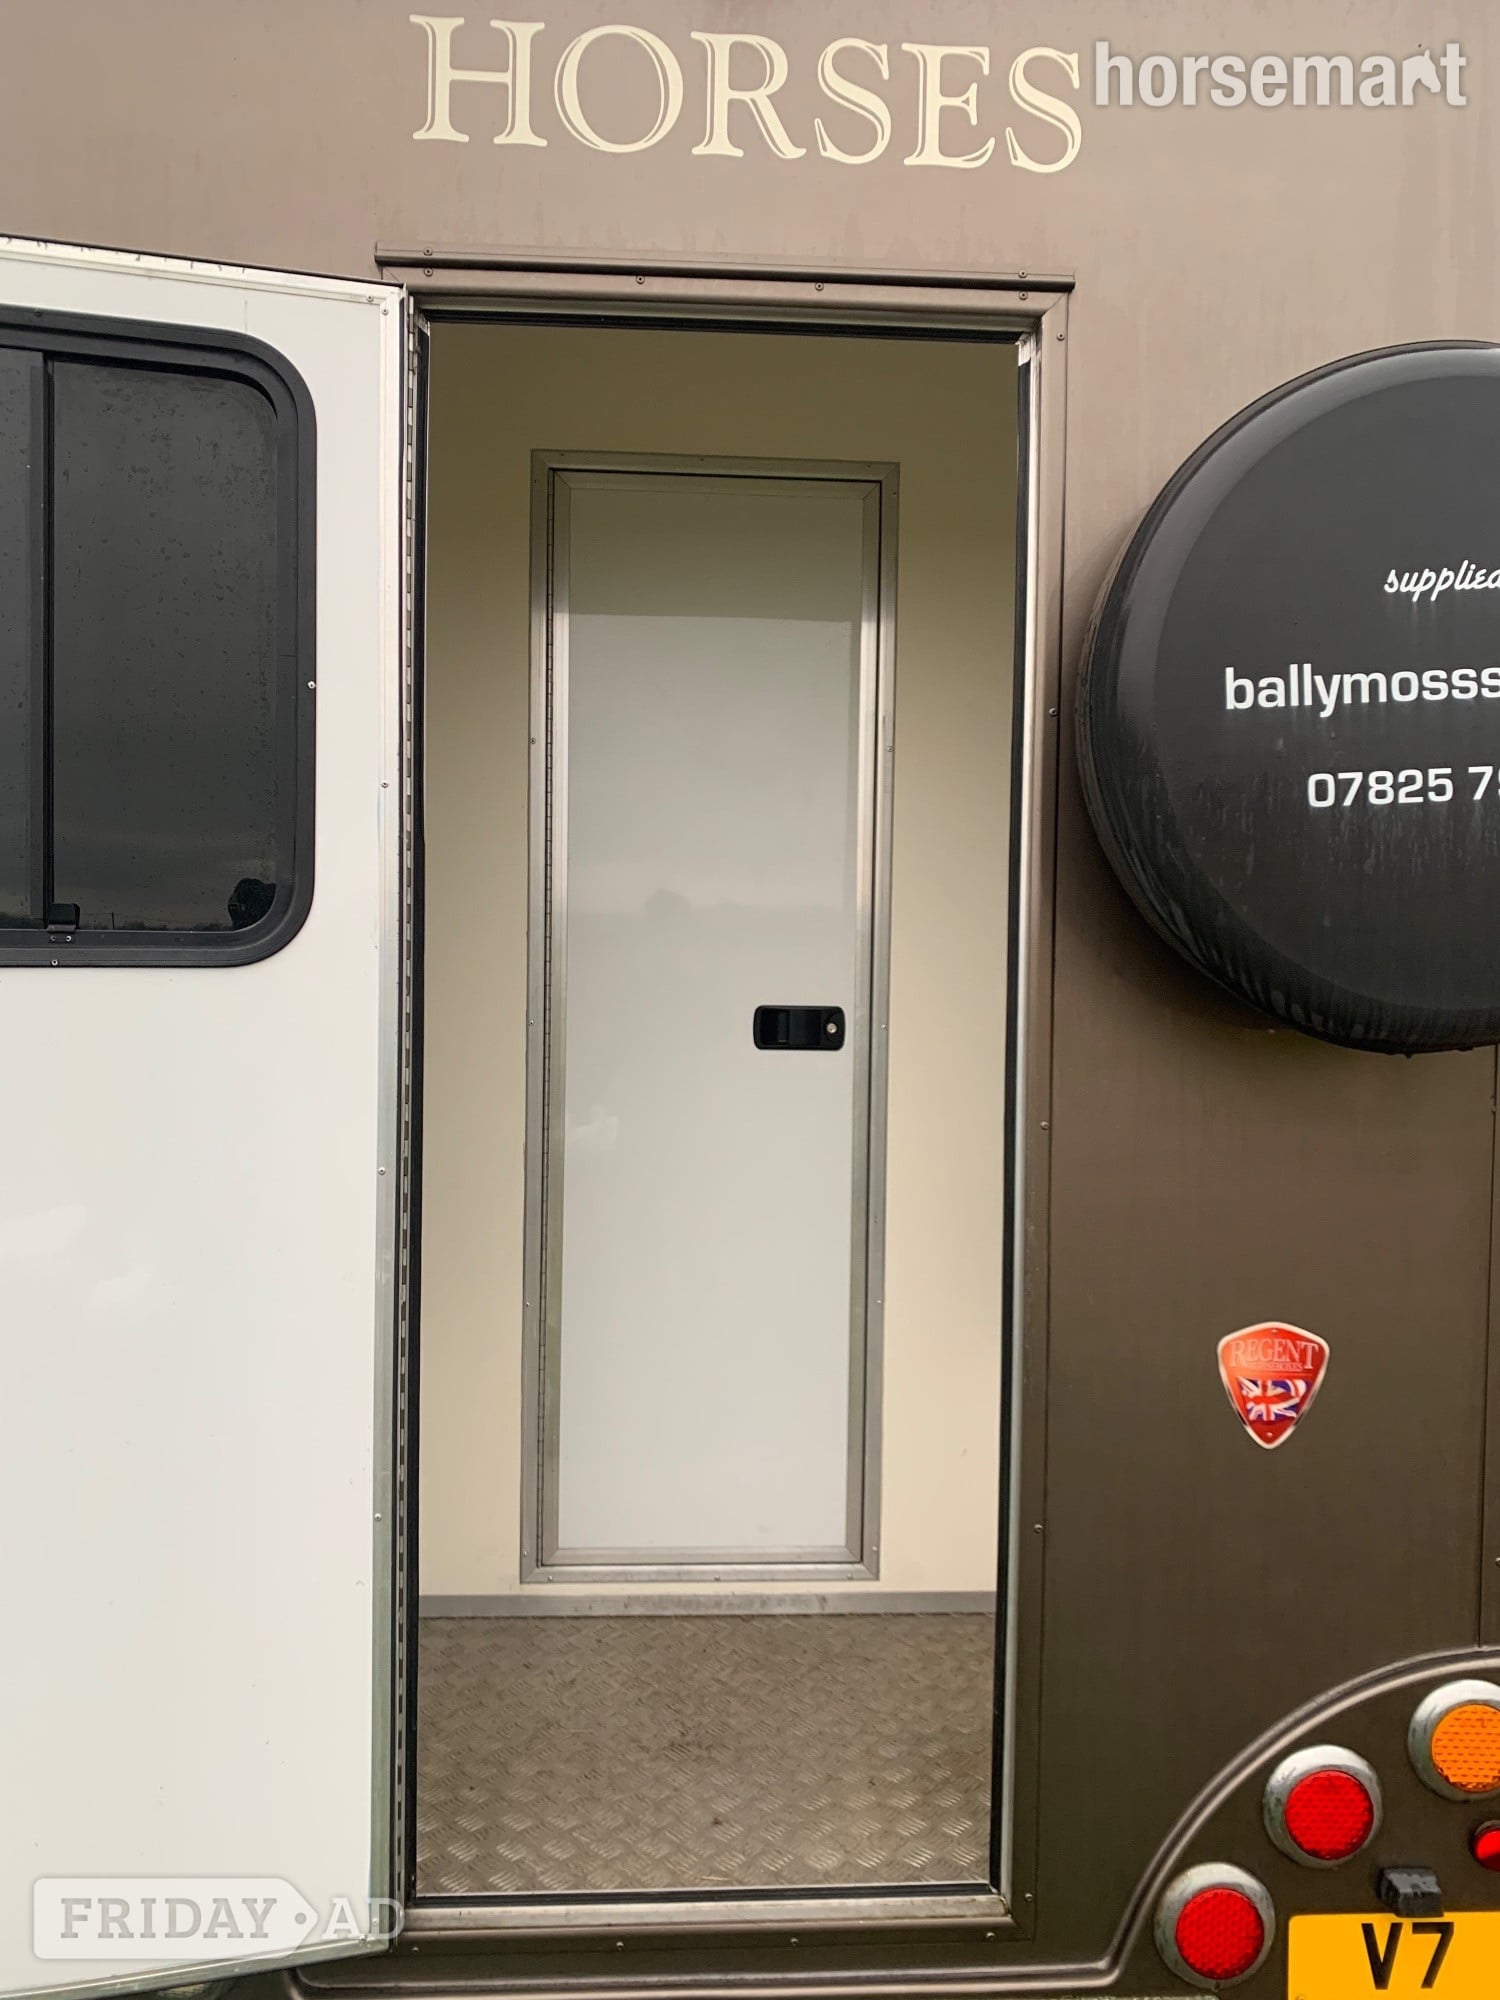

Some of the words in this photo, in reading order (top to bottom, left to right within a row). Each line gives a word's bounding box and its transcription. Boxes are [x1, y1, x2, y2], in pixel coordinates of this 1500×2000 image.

[409, 14, 1083, 173] HORSES
[1307, 767, 1453, 807] 07825
[1468, 766, 1500, 800] 7
[1229, 1338, 1319, 1370] REGENT
[1361, 1921, 1455, 1990] V7
